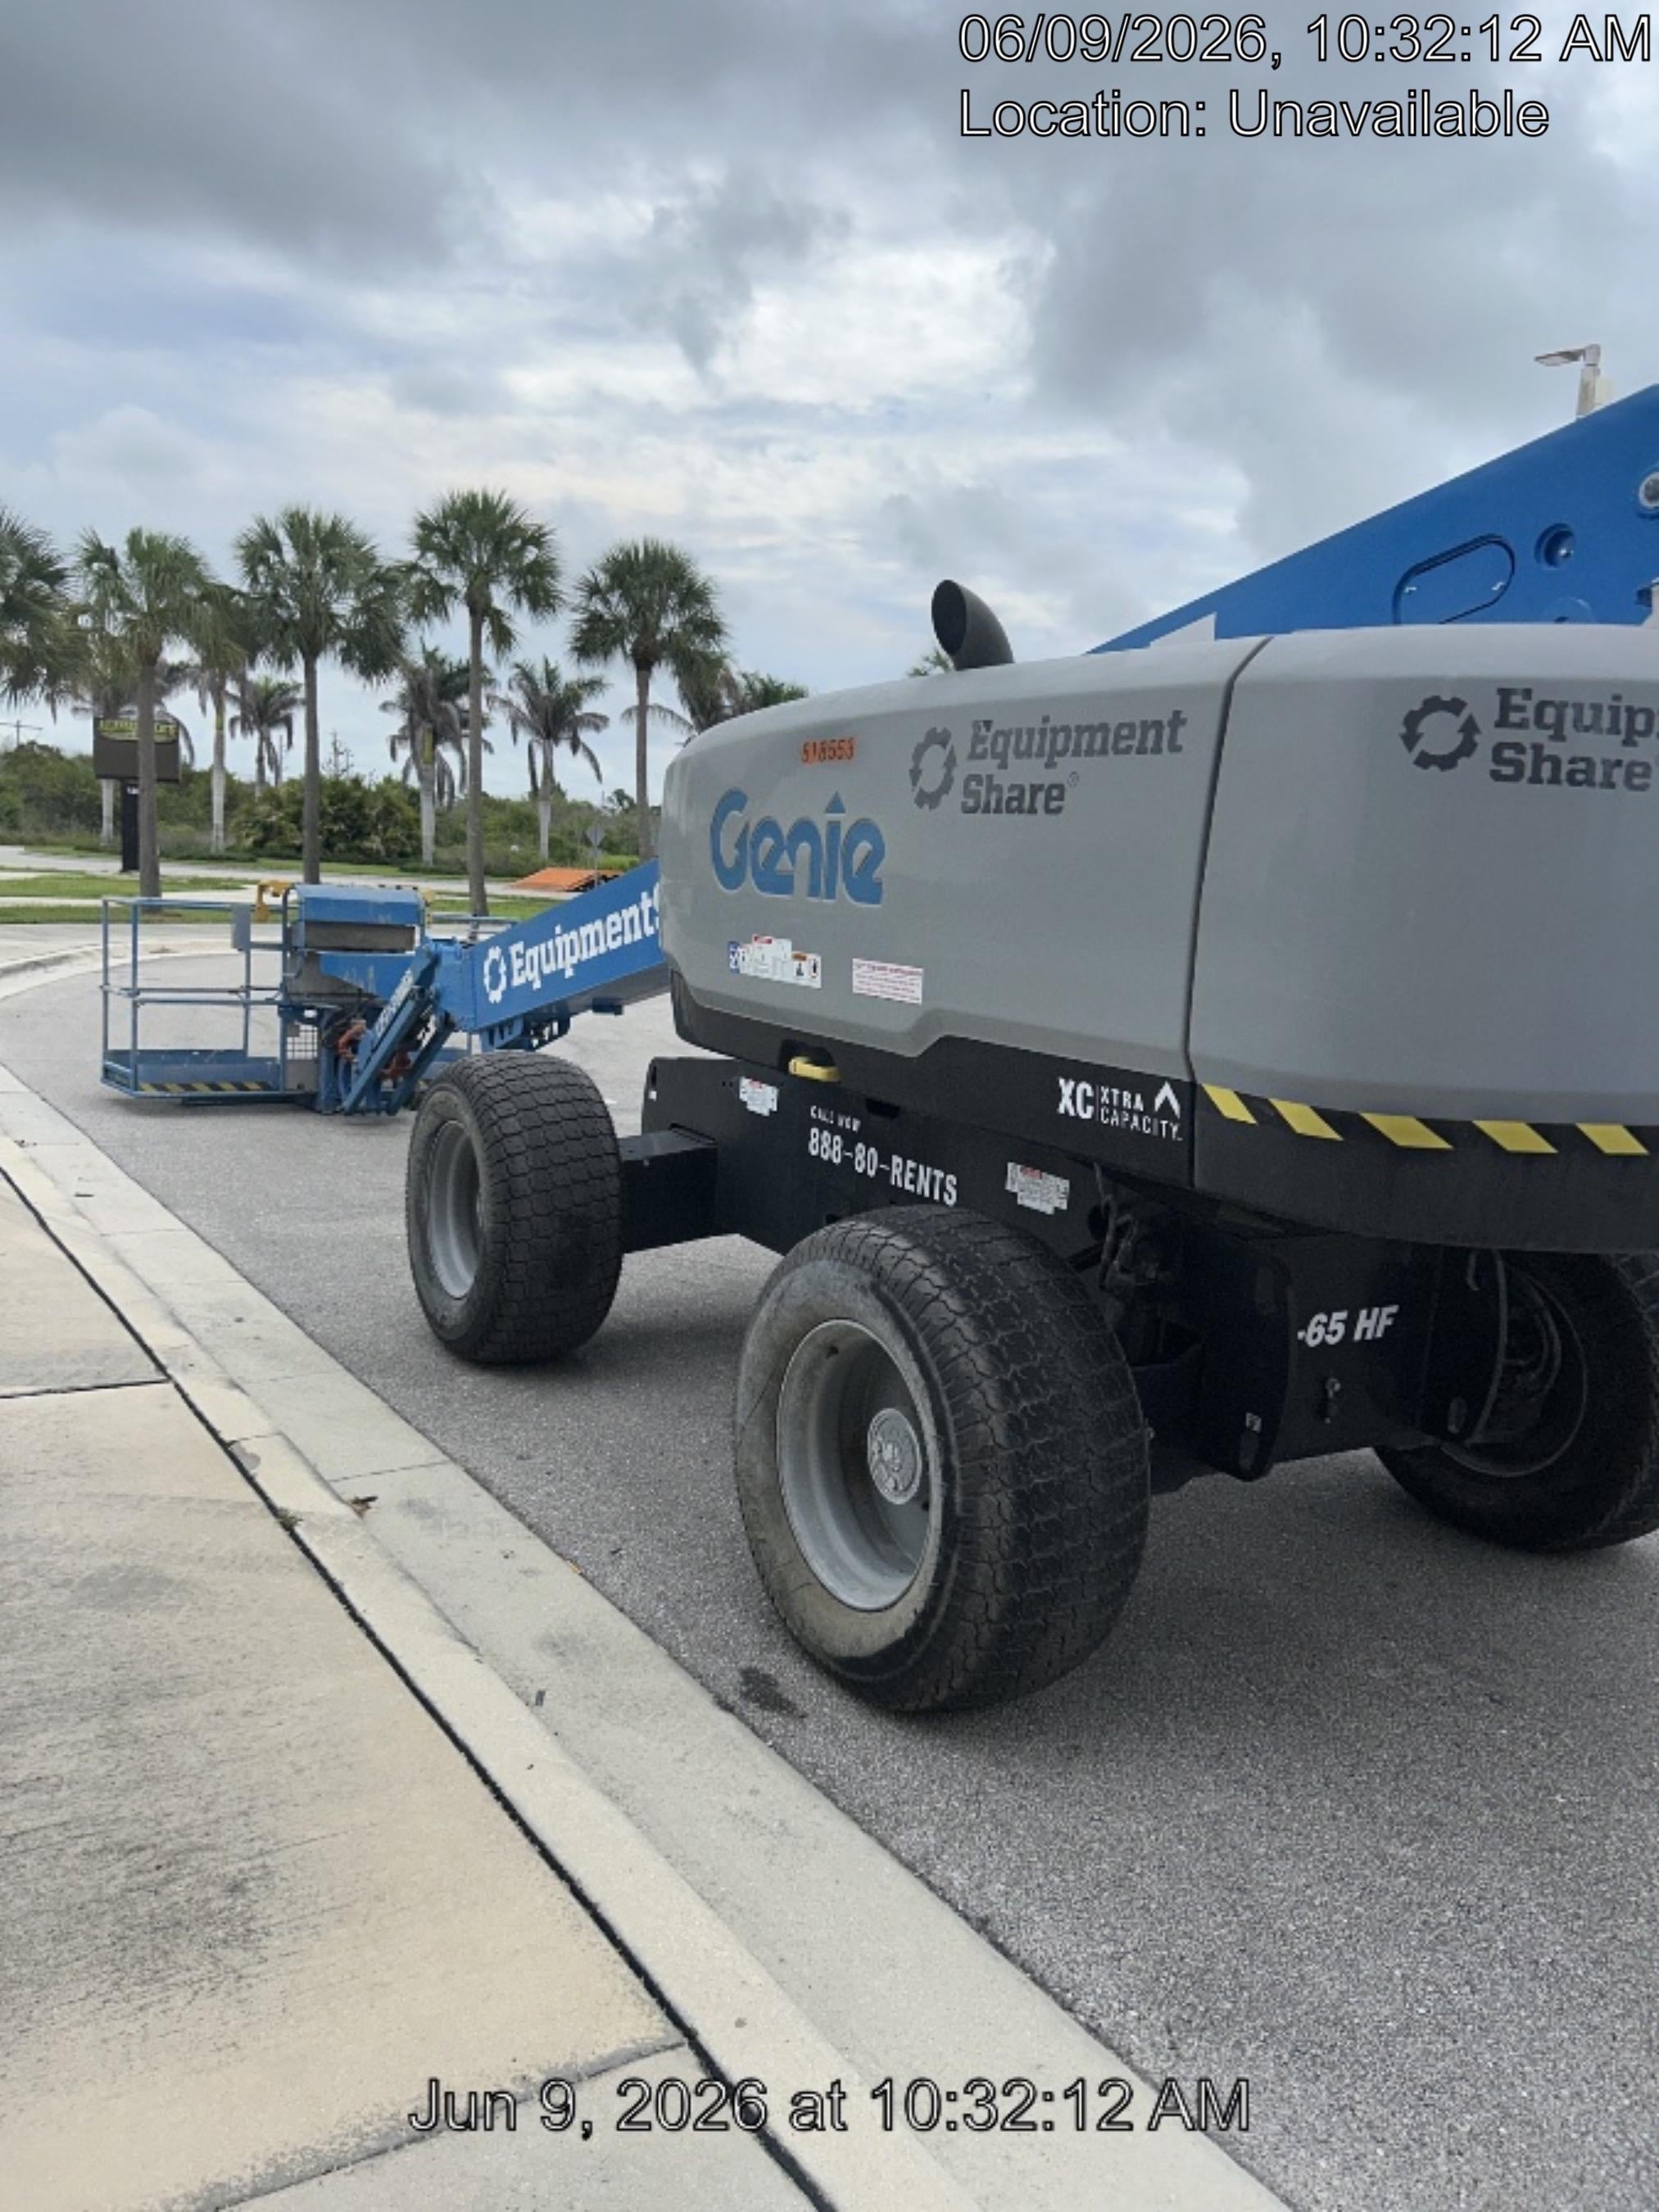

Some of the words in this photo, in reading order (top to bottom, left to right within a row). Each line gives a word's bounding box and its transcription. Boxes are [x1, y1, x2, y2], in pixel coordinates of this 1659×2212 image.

[967, 709, 1188, 770] Equipment
[1494, 687, 1659, 748] Equip
[710, 786, 886, 907] Genie
[1057, 1077, 1095, 1120] XC
[1100, 1085, 1145, 1113] XTRA
[1100, 1105, 1181, 1141] CAPACITY
[808, 1126, 958, 1208] 888-80-RENTS
[1353, 1303, 1399, 1342] HF
